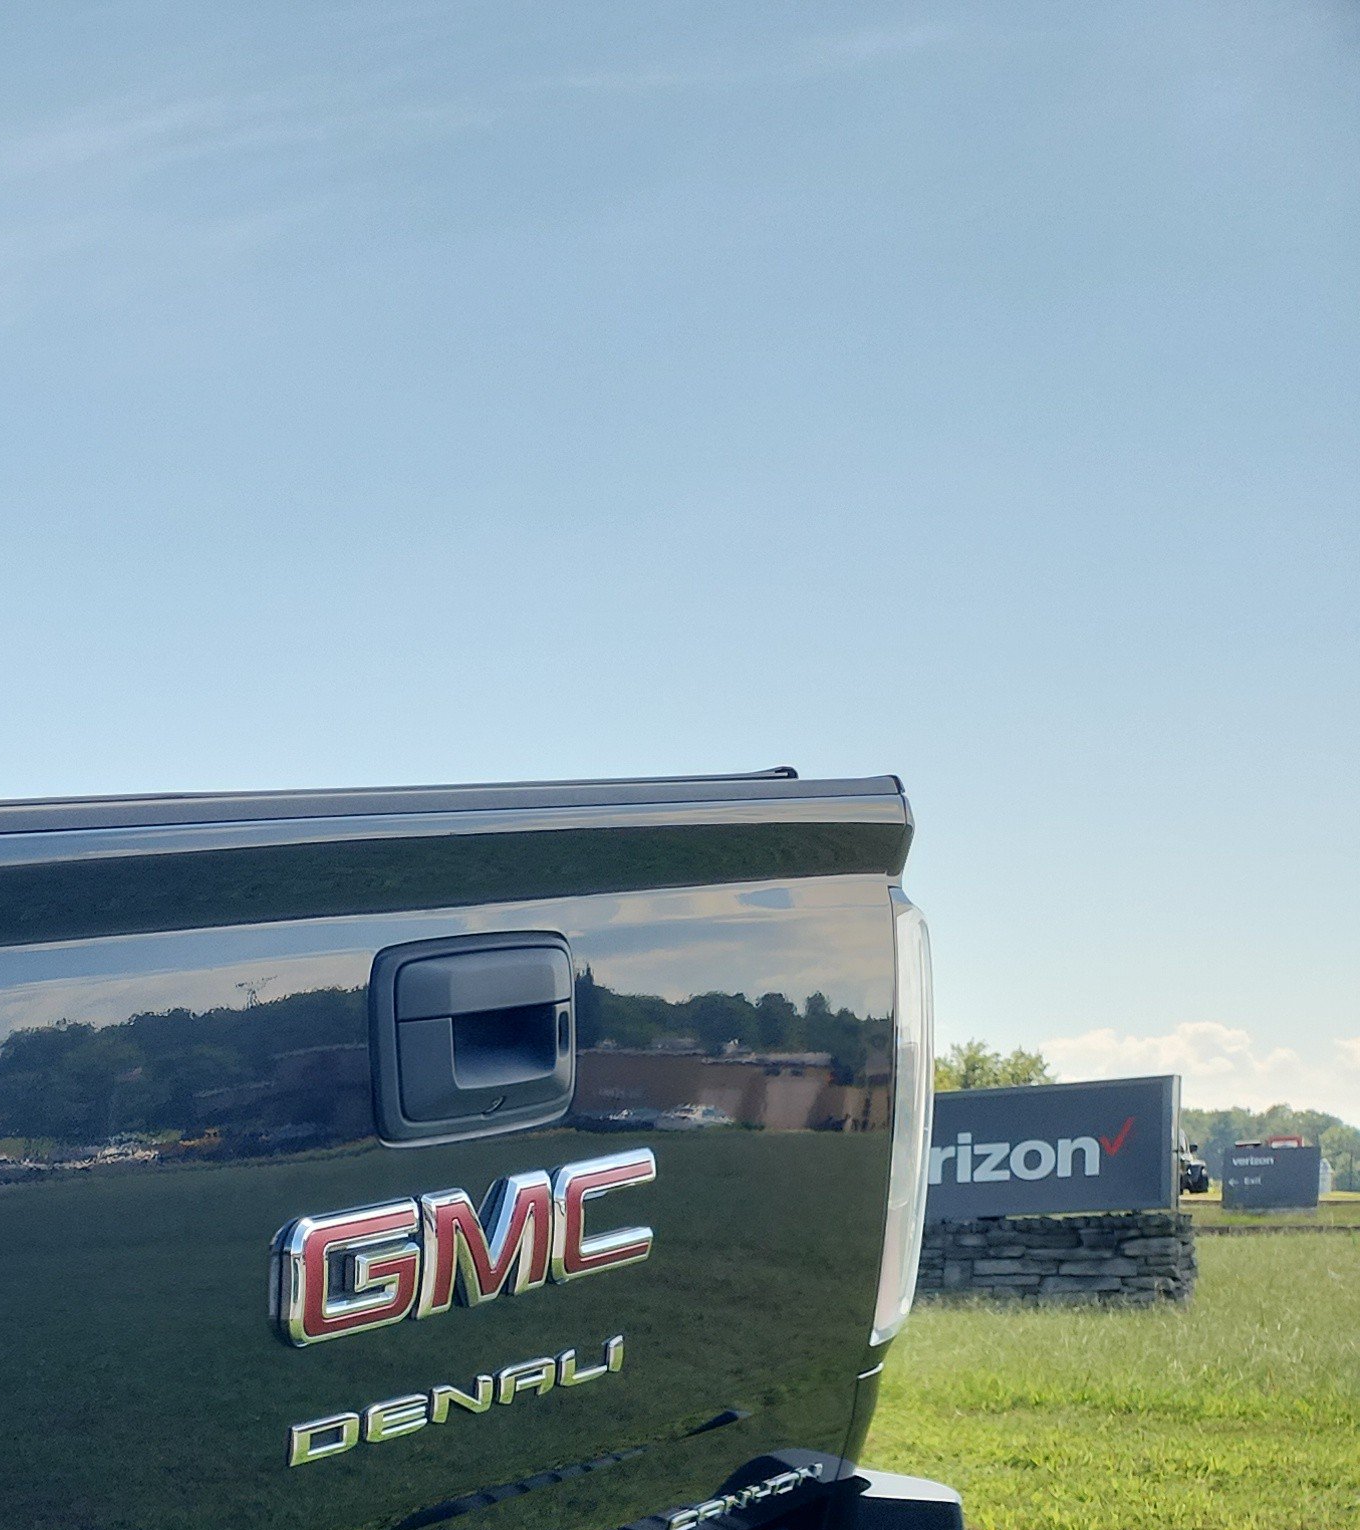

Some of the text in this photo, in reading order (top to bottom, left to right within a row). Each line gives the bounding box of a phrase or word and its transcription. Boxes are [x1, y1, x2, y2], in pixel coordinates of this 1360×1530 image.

[928, 1132, 1100, 1185] rizon
[1231, 1155, 1275, 1167] verizon
[280, 1147, 657, 1347] GMC
[288, 1334, 624, 1467] DENALI
